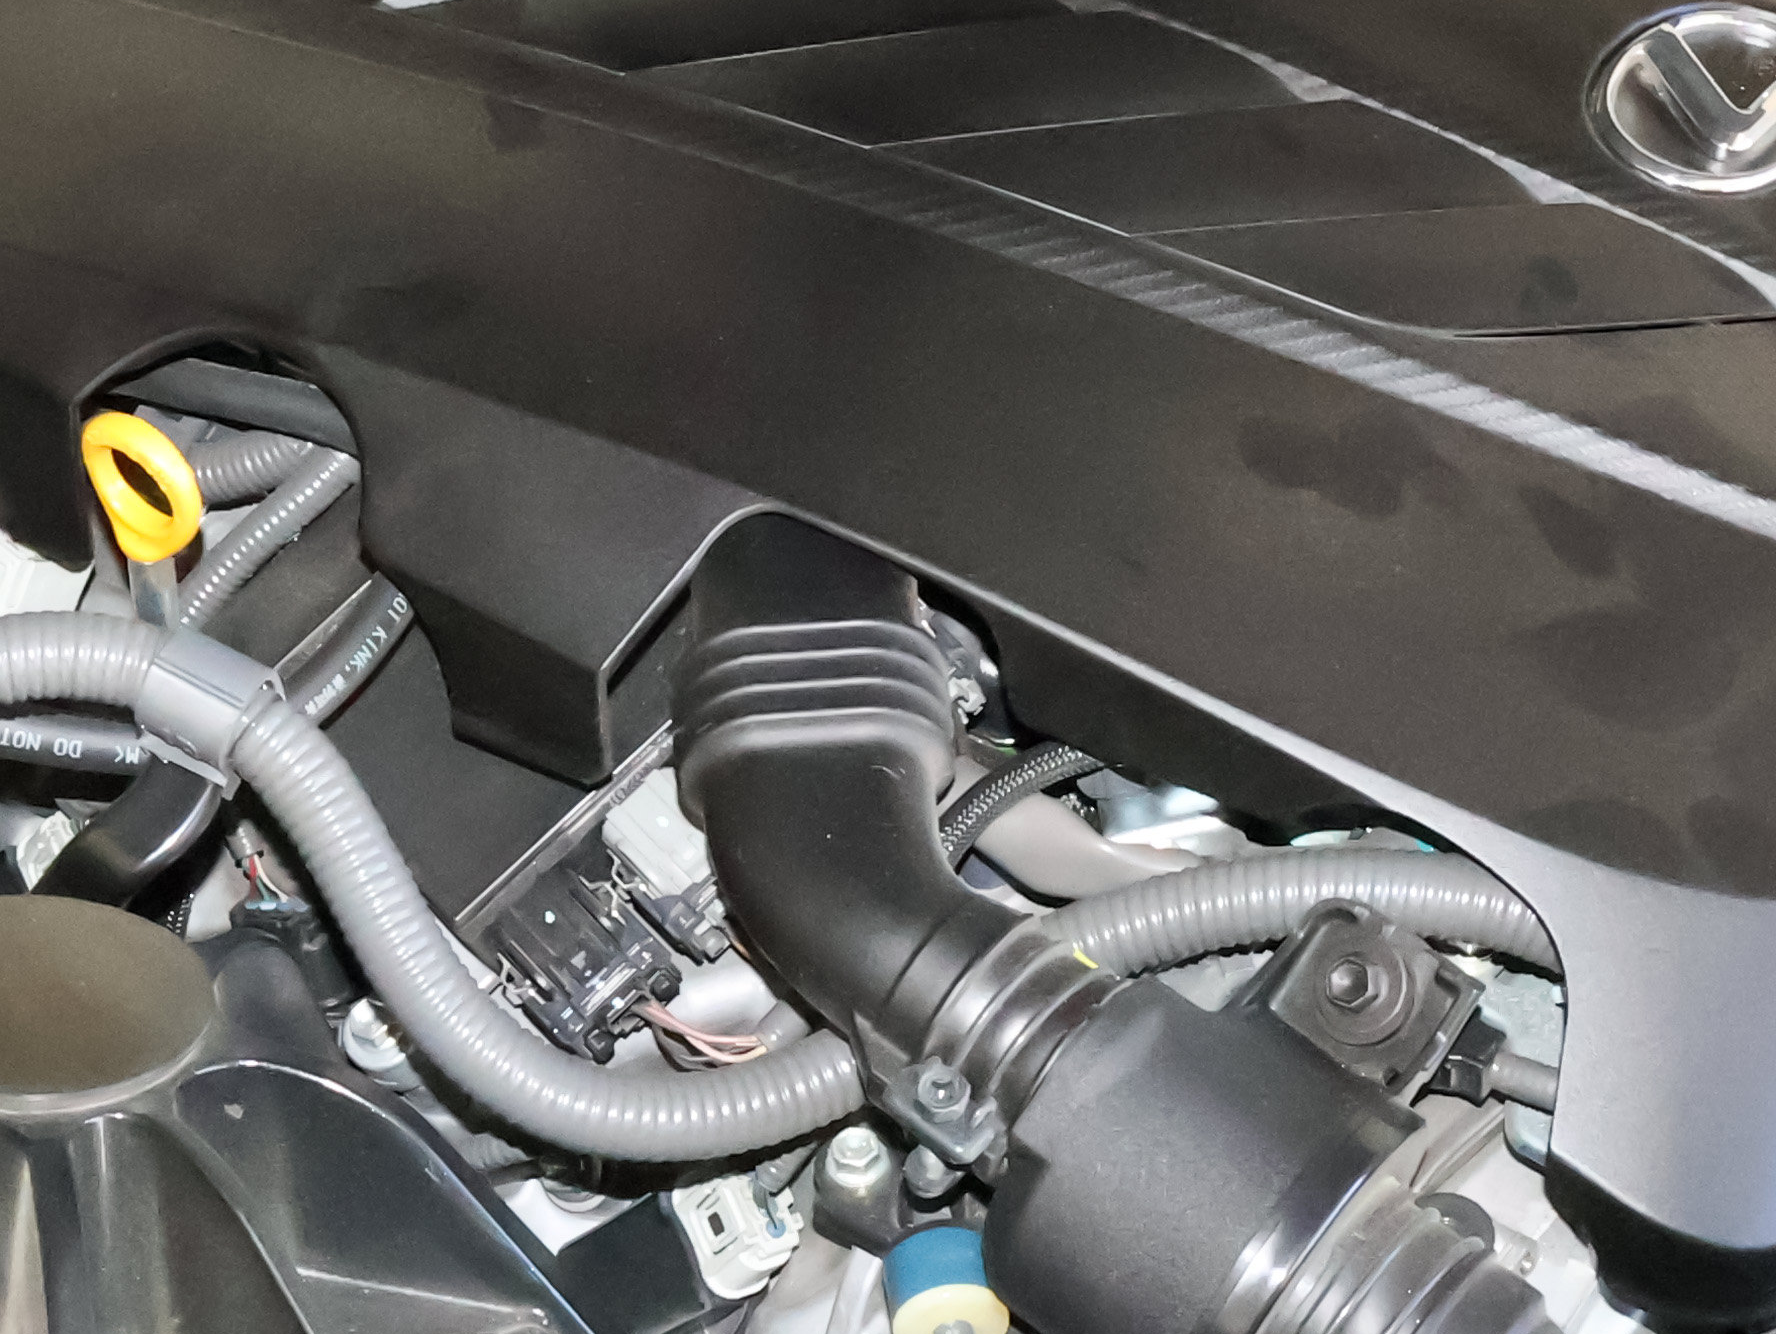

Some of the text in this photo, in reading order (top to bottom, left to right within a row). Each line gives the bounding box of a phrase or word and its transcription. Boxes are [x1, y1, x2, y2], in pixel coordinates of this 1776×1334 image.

[345, 625, 388, 672] KINK,
[0, 727, 42, 751] NOT
[53, 737, 83, 759] DO
